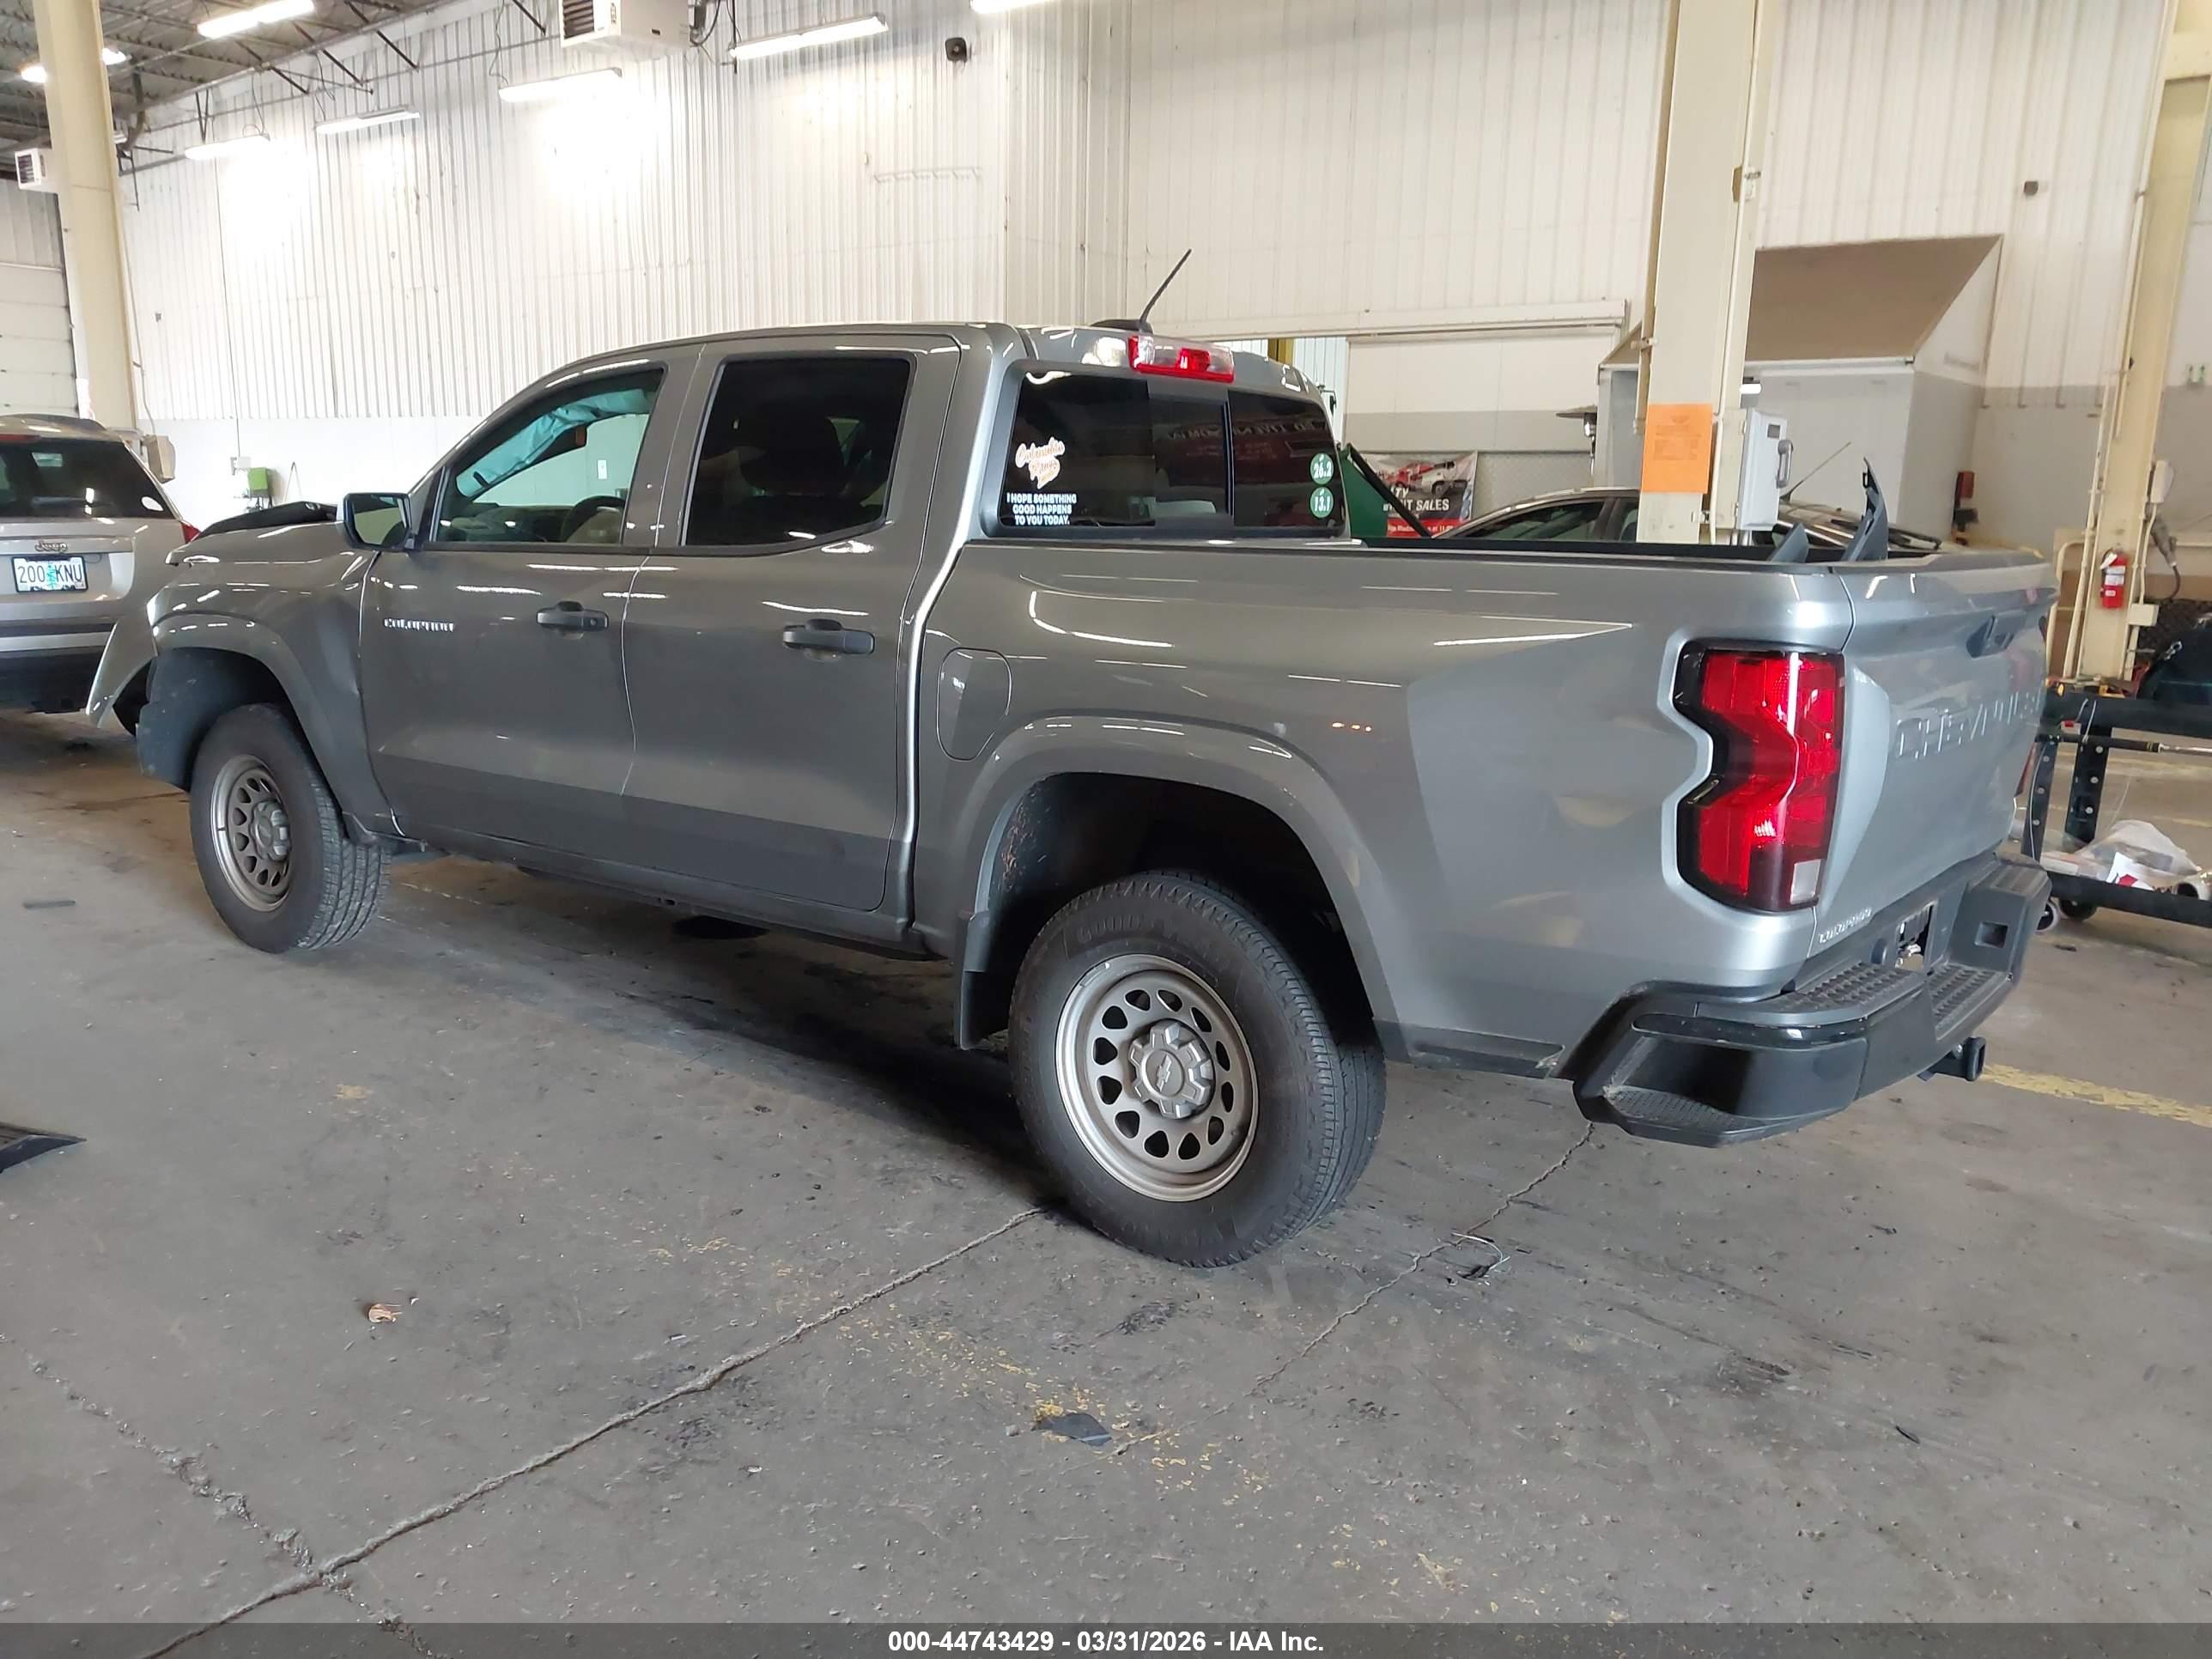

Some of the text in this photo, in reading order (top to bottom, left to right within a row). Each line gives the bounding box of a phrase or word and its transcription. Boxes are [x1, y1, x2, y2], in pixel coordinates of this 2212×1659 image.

[1313, 461, 1332, 478] 26.2
[1006, 493, 1077, 503] I HOPE SOMETHING
[1314, 495, 1331, 512] 13.1
[1012, 504, 1072, 514] GOOD HAPPENS
[1415, 498, 1449, 511] SALES
[1014, 515, 1070, 525] TO YOU TODAY.
[35, 541, 68, 553] Jeep
[17, 563, 83, 584] 200 KNU
